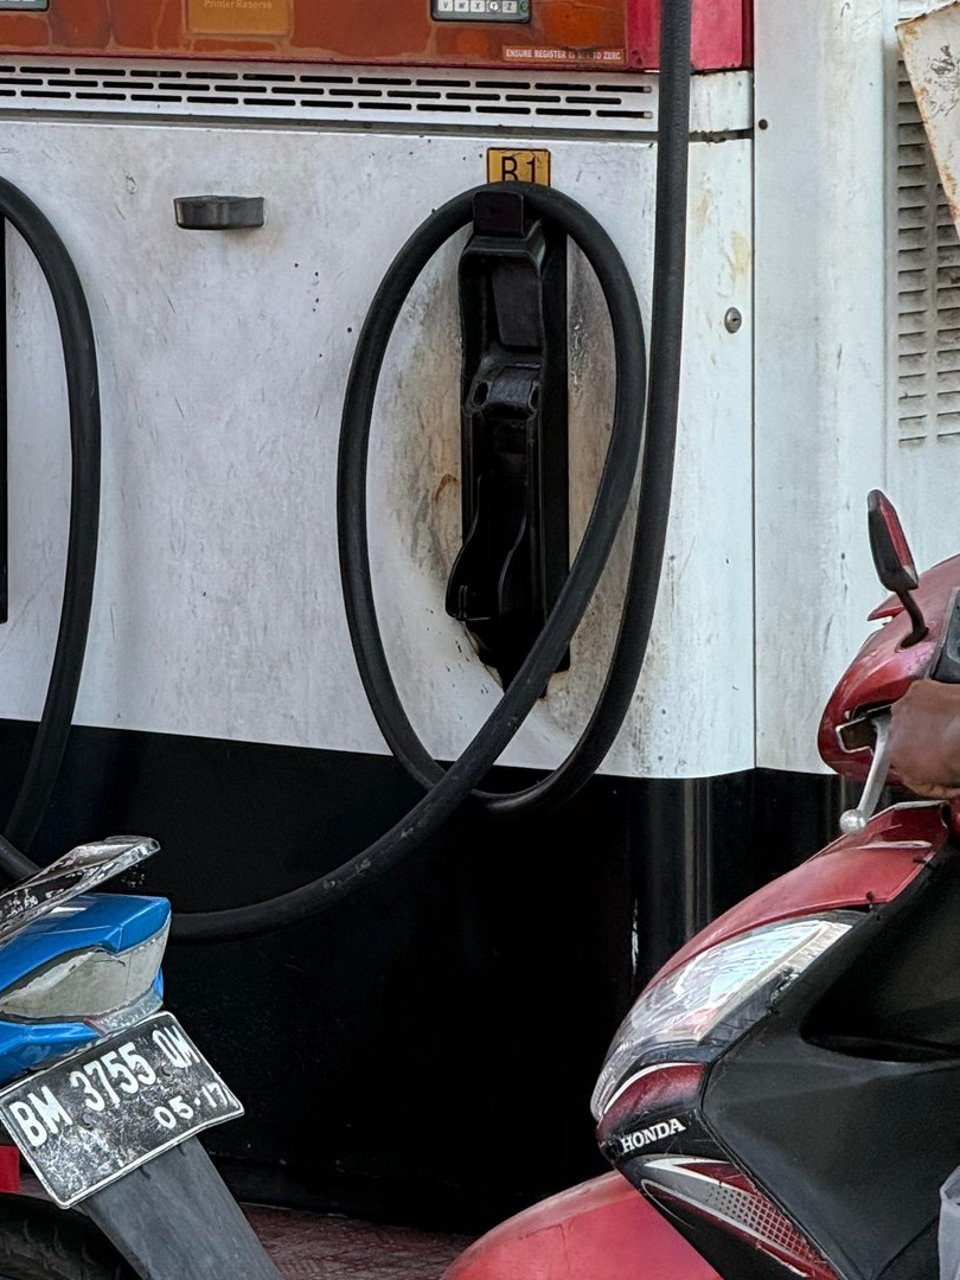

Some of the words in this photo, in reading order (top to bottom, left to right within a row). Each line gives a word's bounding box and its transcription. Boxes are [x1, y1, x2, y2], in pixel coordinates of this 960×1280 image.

[505, 48, 532, 58] ENSURE
[534, 49, 567, 59] REGISTER
[9, 1085, 73, 1147] BM
[70, 1041, 157, 1112] 3755
[620, 1118, 687, 1154] HONDA
